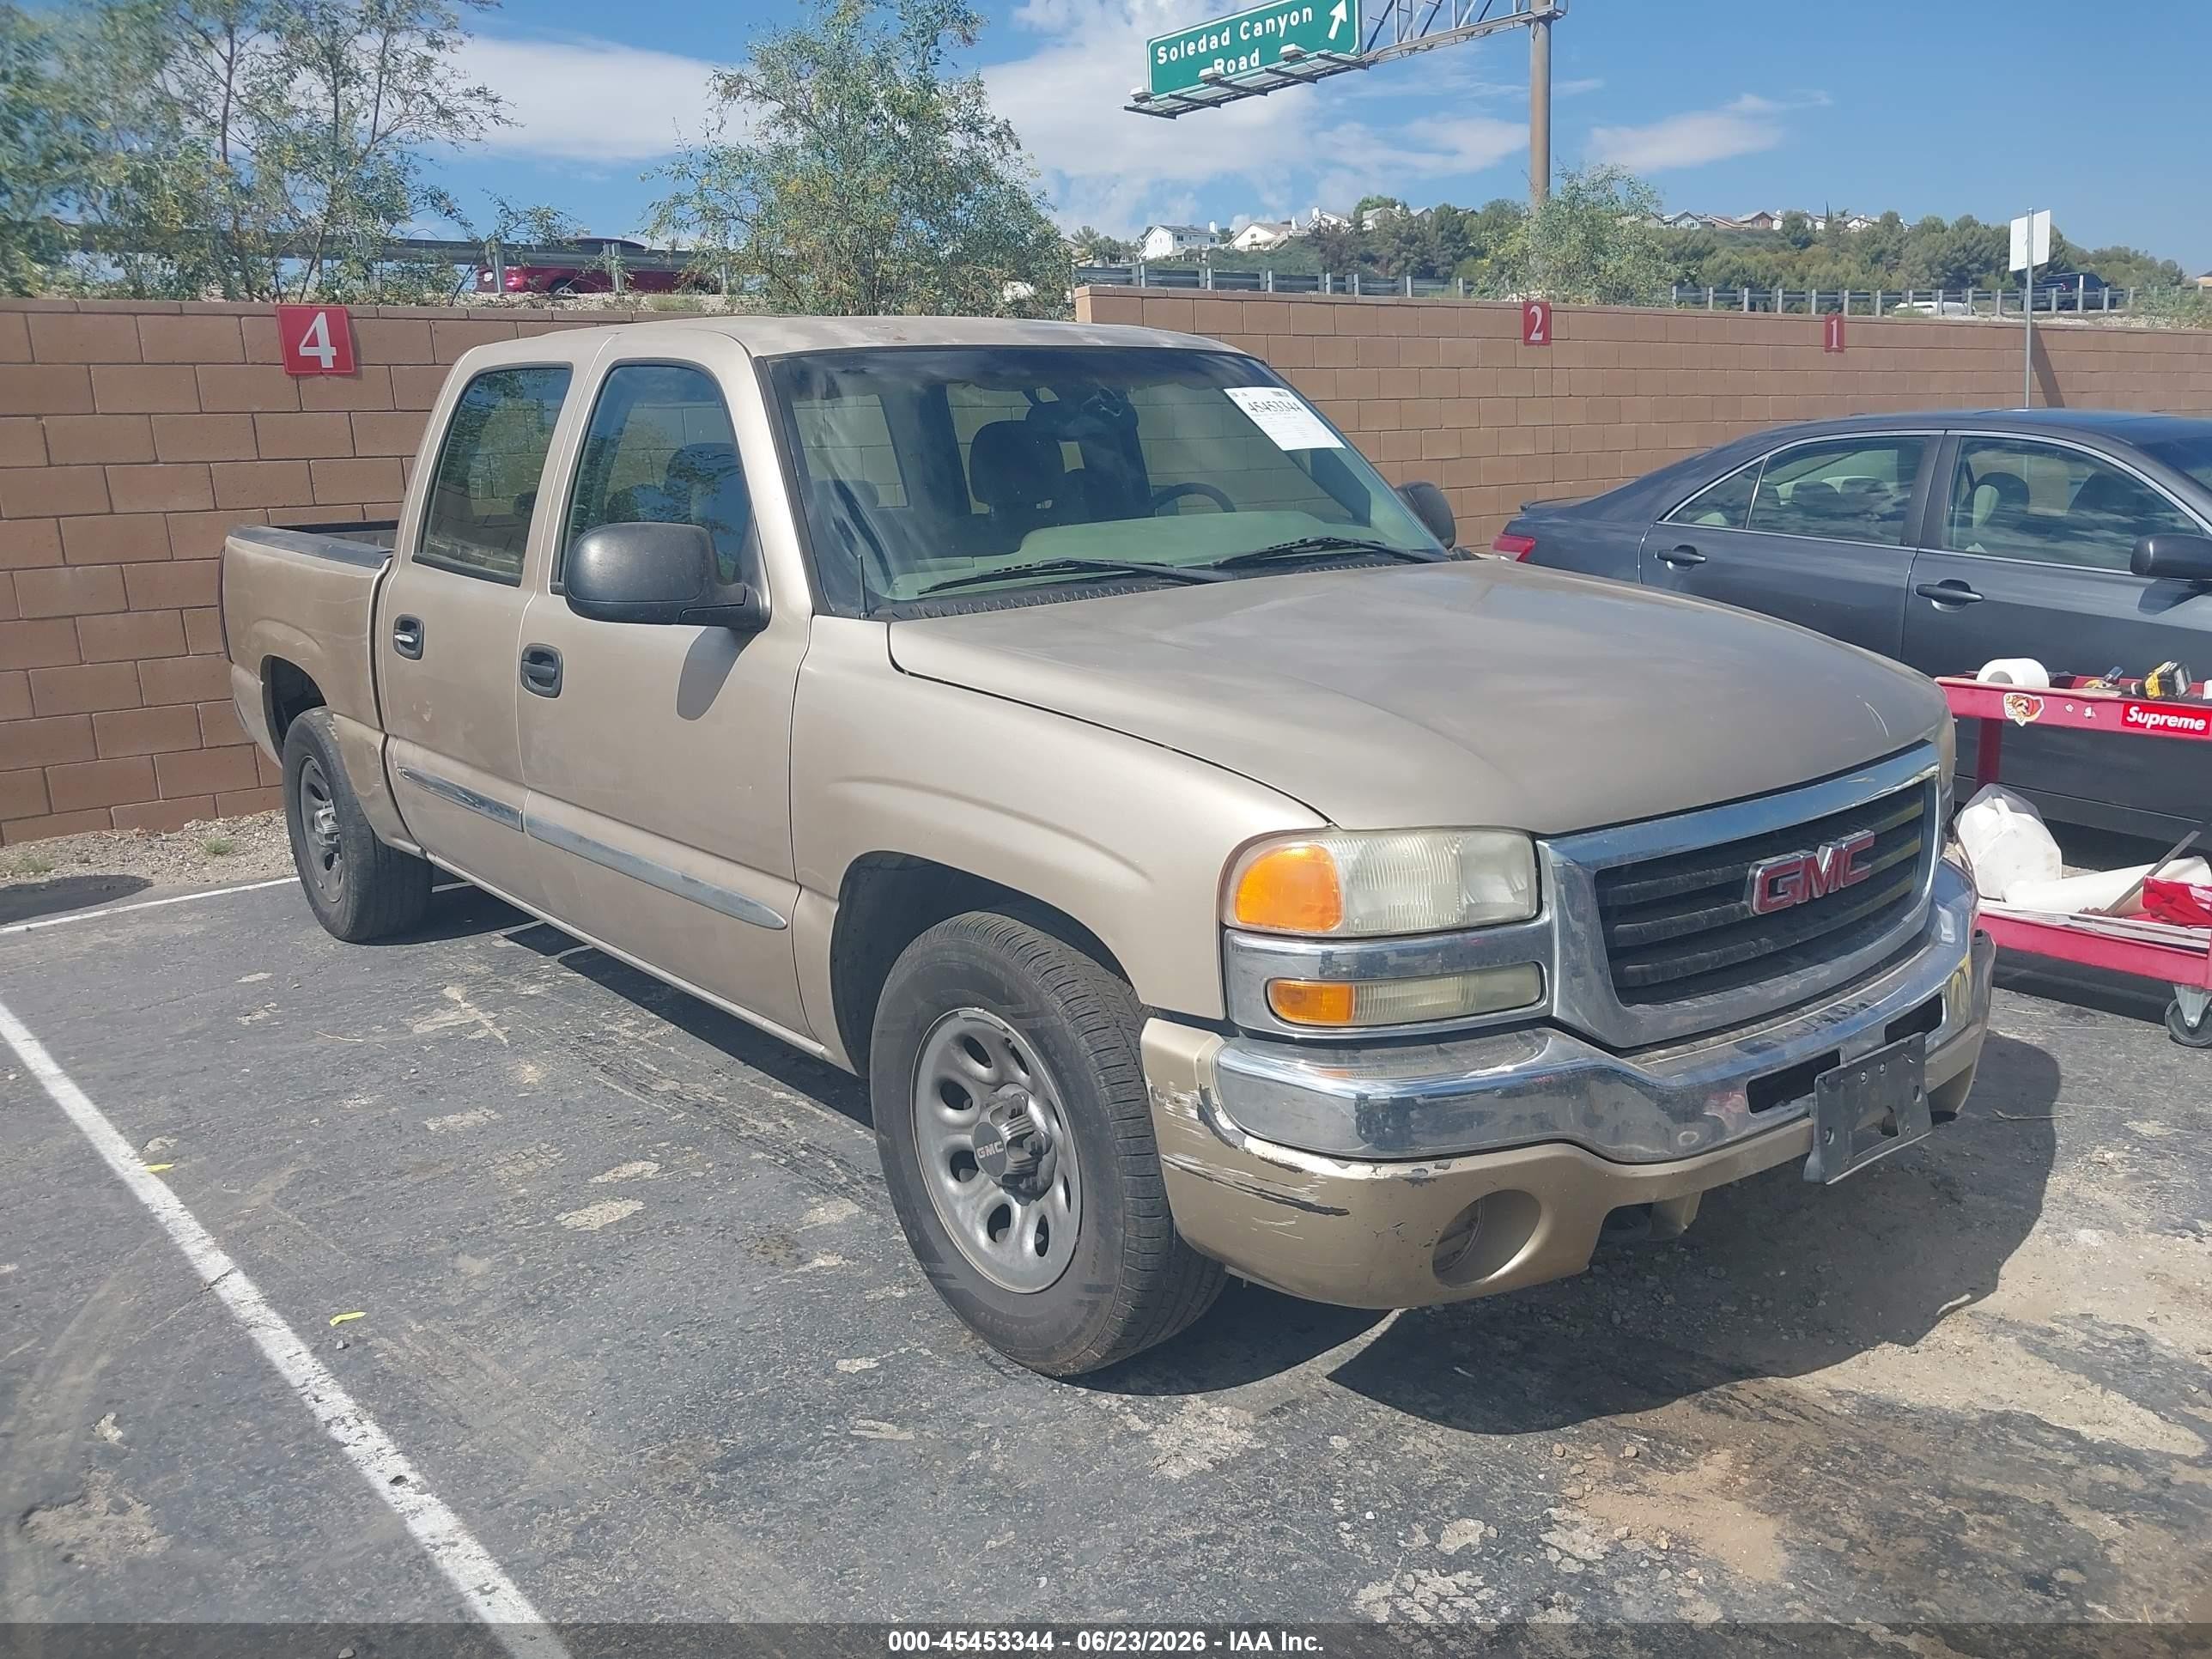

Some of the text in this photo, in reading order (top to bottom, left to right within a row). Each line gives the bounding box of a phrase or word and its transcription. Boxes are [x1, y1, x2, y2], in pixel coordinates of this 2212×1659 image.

[1157, 6, 1313, 65] Soledad Canyon
[1213, 47, 1260, 74] Road
[1528, 305, 1544, 341] 2
[1830, 319, 1839, 349] 1
[299, 312, 337, 368] 4
[1248, 400, 1303, 412] 45453344
[2126, 705, 2207, 731] Supreme
[1752, 829, 1875, 915] GMC
[975, 1140, 1005, 1159] GMC
